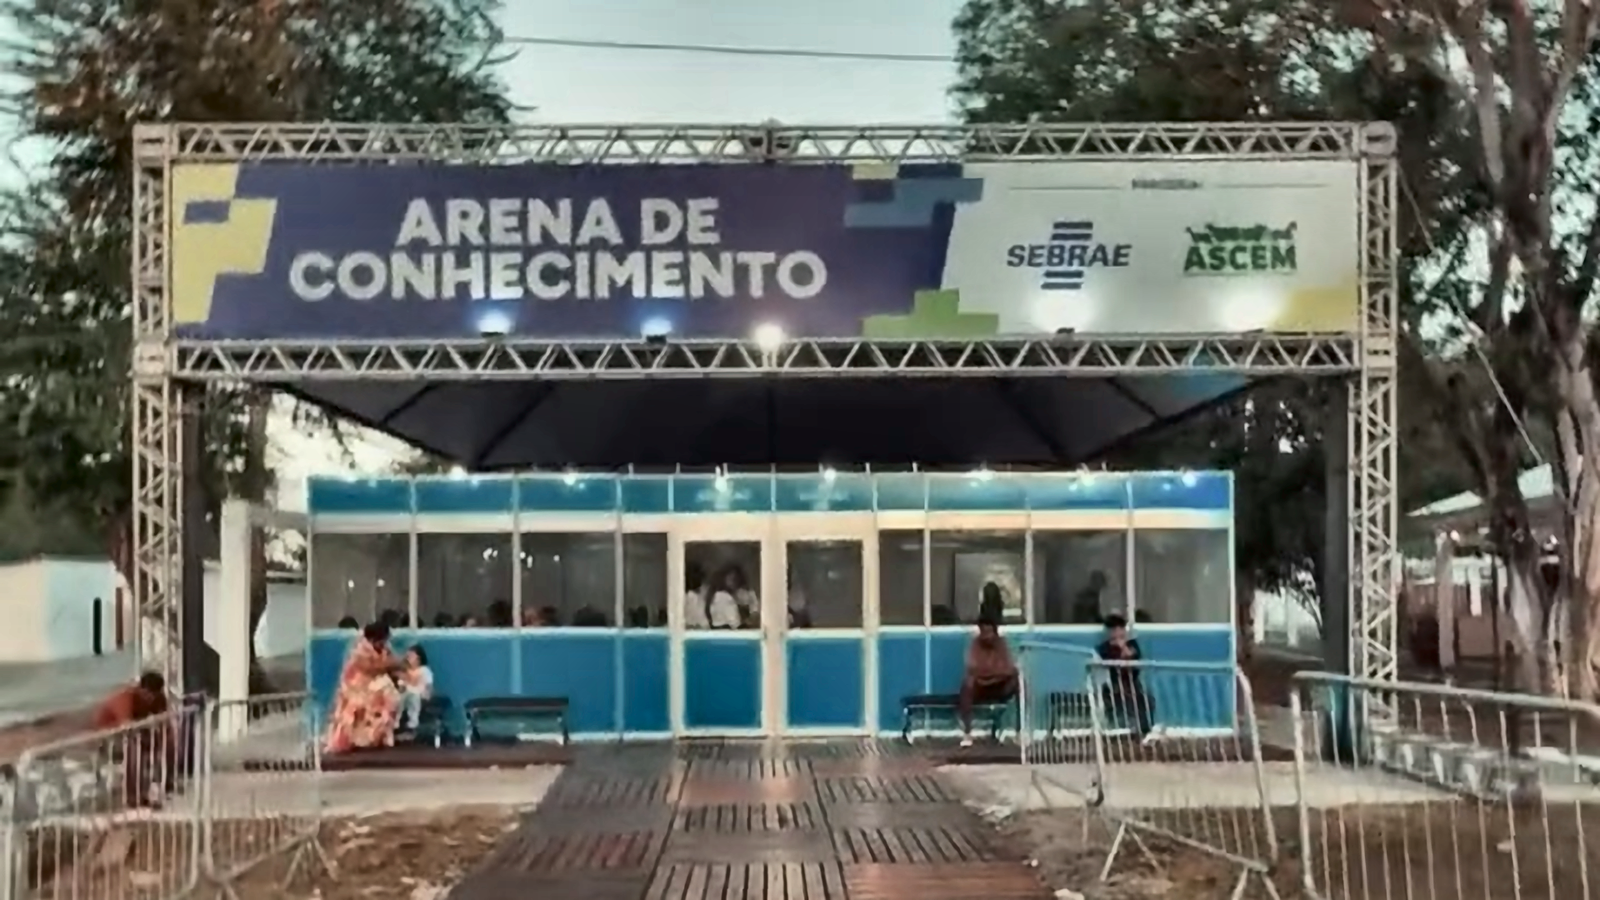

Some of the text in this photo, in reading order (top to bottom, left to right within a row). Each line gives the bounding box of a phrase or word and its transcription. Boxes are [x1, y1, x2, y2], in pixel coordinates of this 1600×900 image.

[395, 197, 721, 246] ARENA DE
[1007, 243, 1133, 267] SEBRAE
[1184, 244, 1298, 271] ASCEM
[289, 250, 827, 301] CONHECIMENTO
